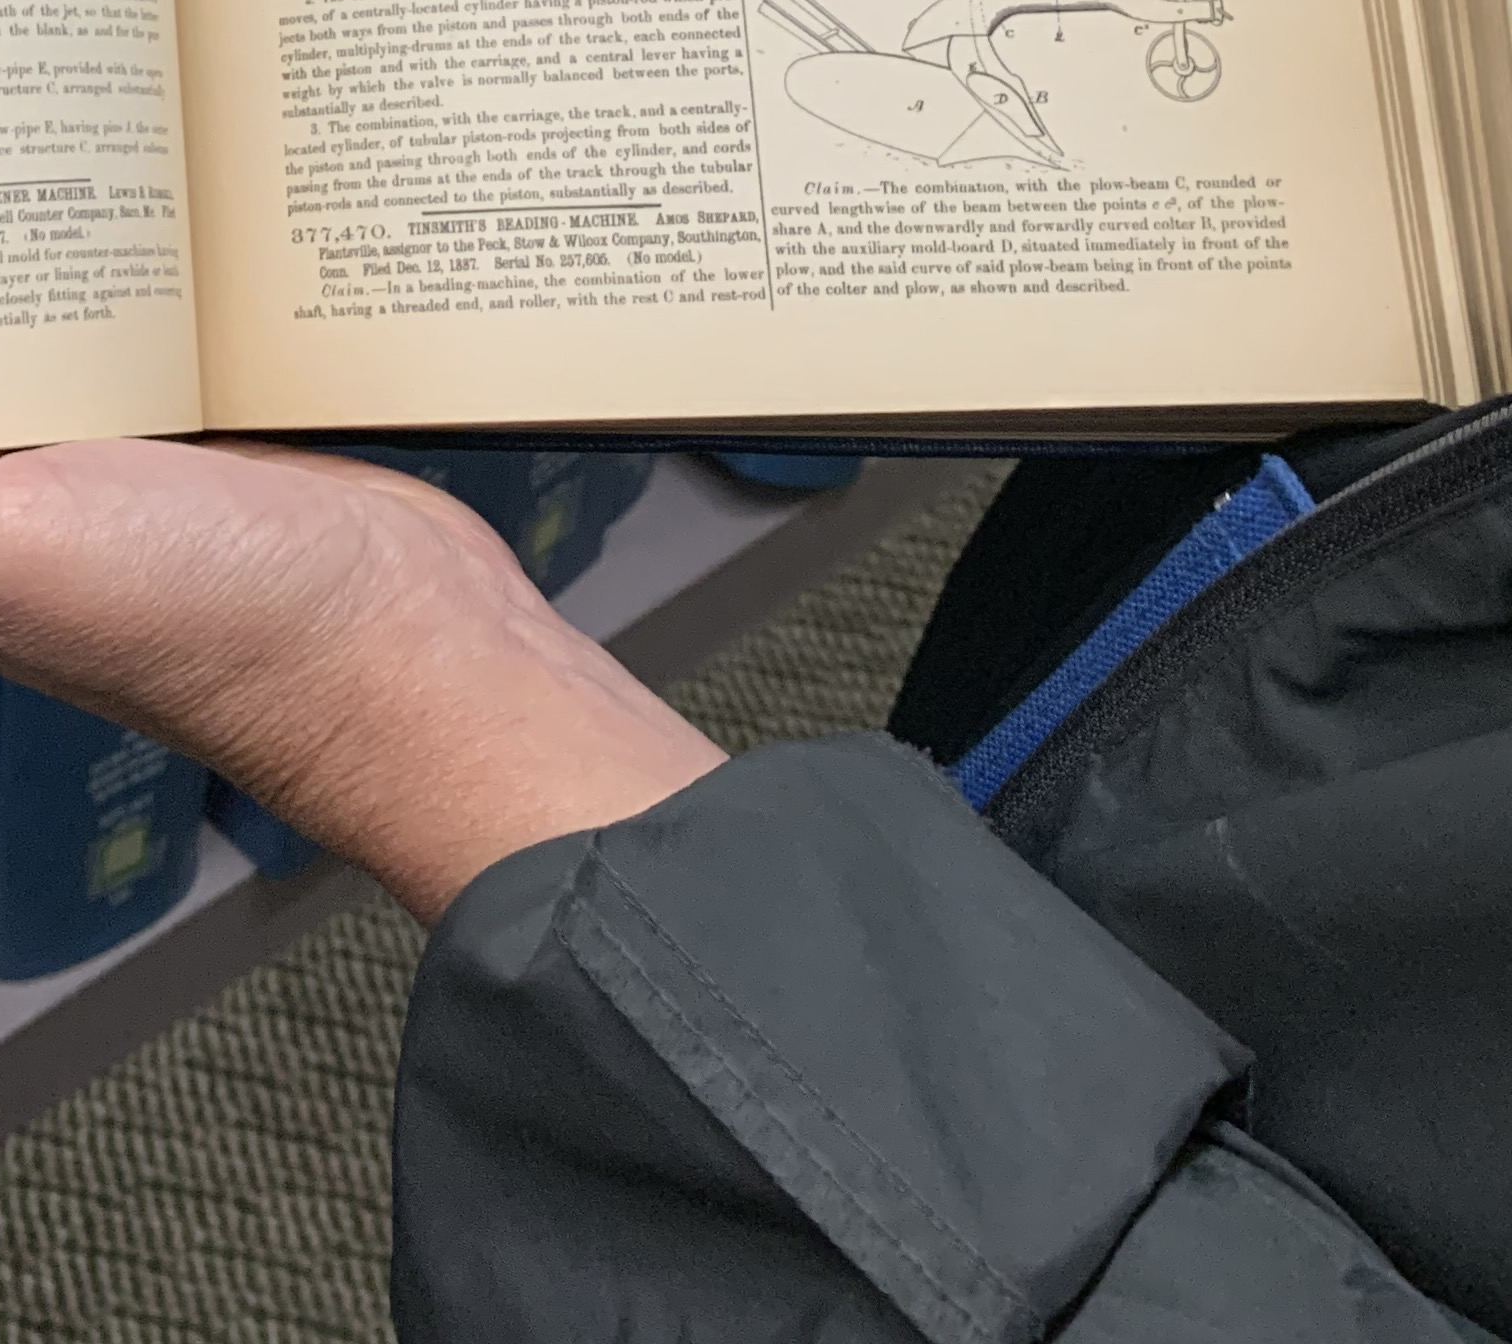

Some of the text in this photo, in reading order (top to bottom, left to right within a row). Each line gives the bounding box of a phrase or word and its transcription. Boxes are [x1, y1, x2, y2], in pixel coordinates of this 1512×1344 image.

[775, 240, 806, 255] with
[812, 241, 835, 255] the
[841, 239, 905, 257] auxiliary
[912, 239, 994, 254] mold-board
[1021, 237, 1079, 252] situated
[1085, 236, 1176, 254] immediately
[1182, 236, 1196, 250] in
[1202, 236, 1238, 250] front
[1244, 236, 1261, 249] of
[1265, 236, 1289, 250] the
